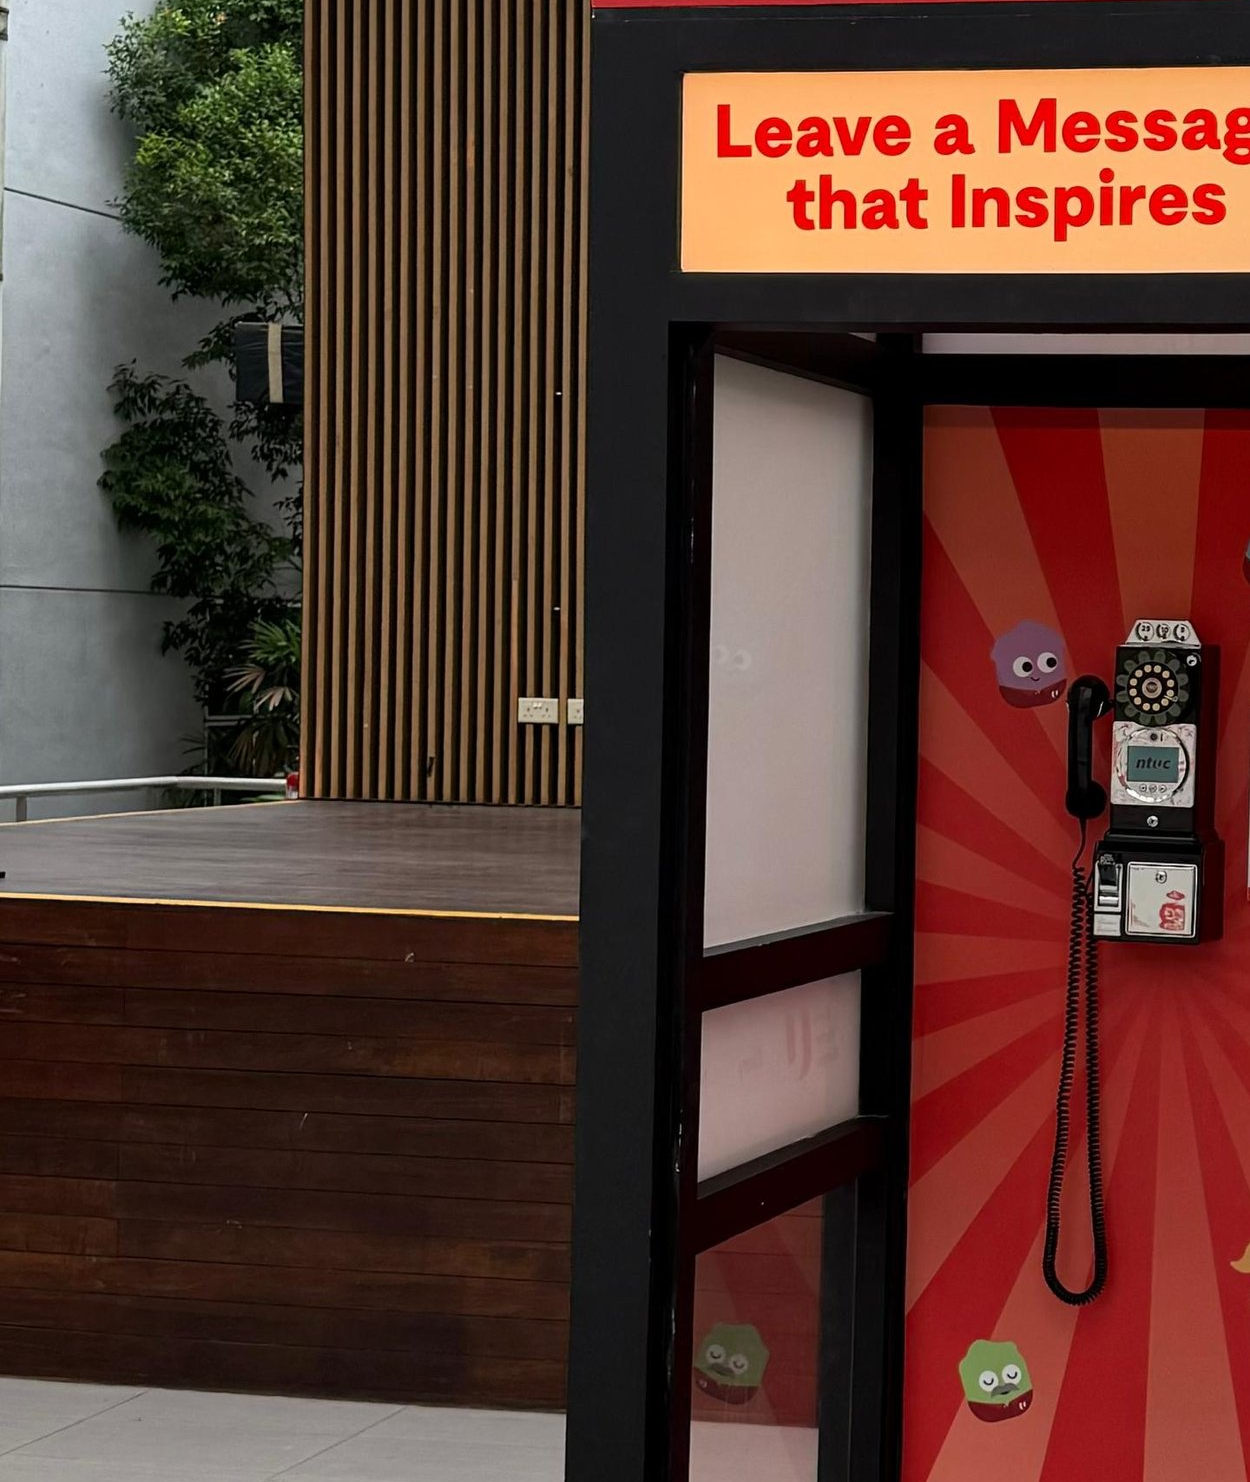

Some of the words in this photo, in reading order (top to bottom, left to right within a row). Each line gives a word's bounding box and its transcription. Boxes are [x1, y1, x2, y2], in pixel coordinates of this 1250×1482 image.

[716, 103, 911, 158] Leave
[933, 113, 975, 155] a
[786, 173, 928, 230] that
[951, 167, 1227, 242] Inspires
[1135, 756, 1172, 769] ntuc
